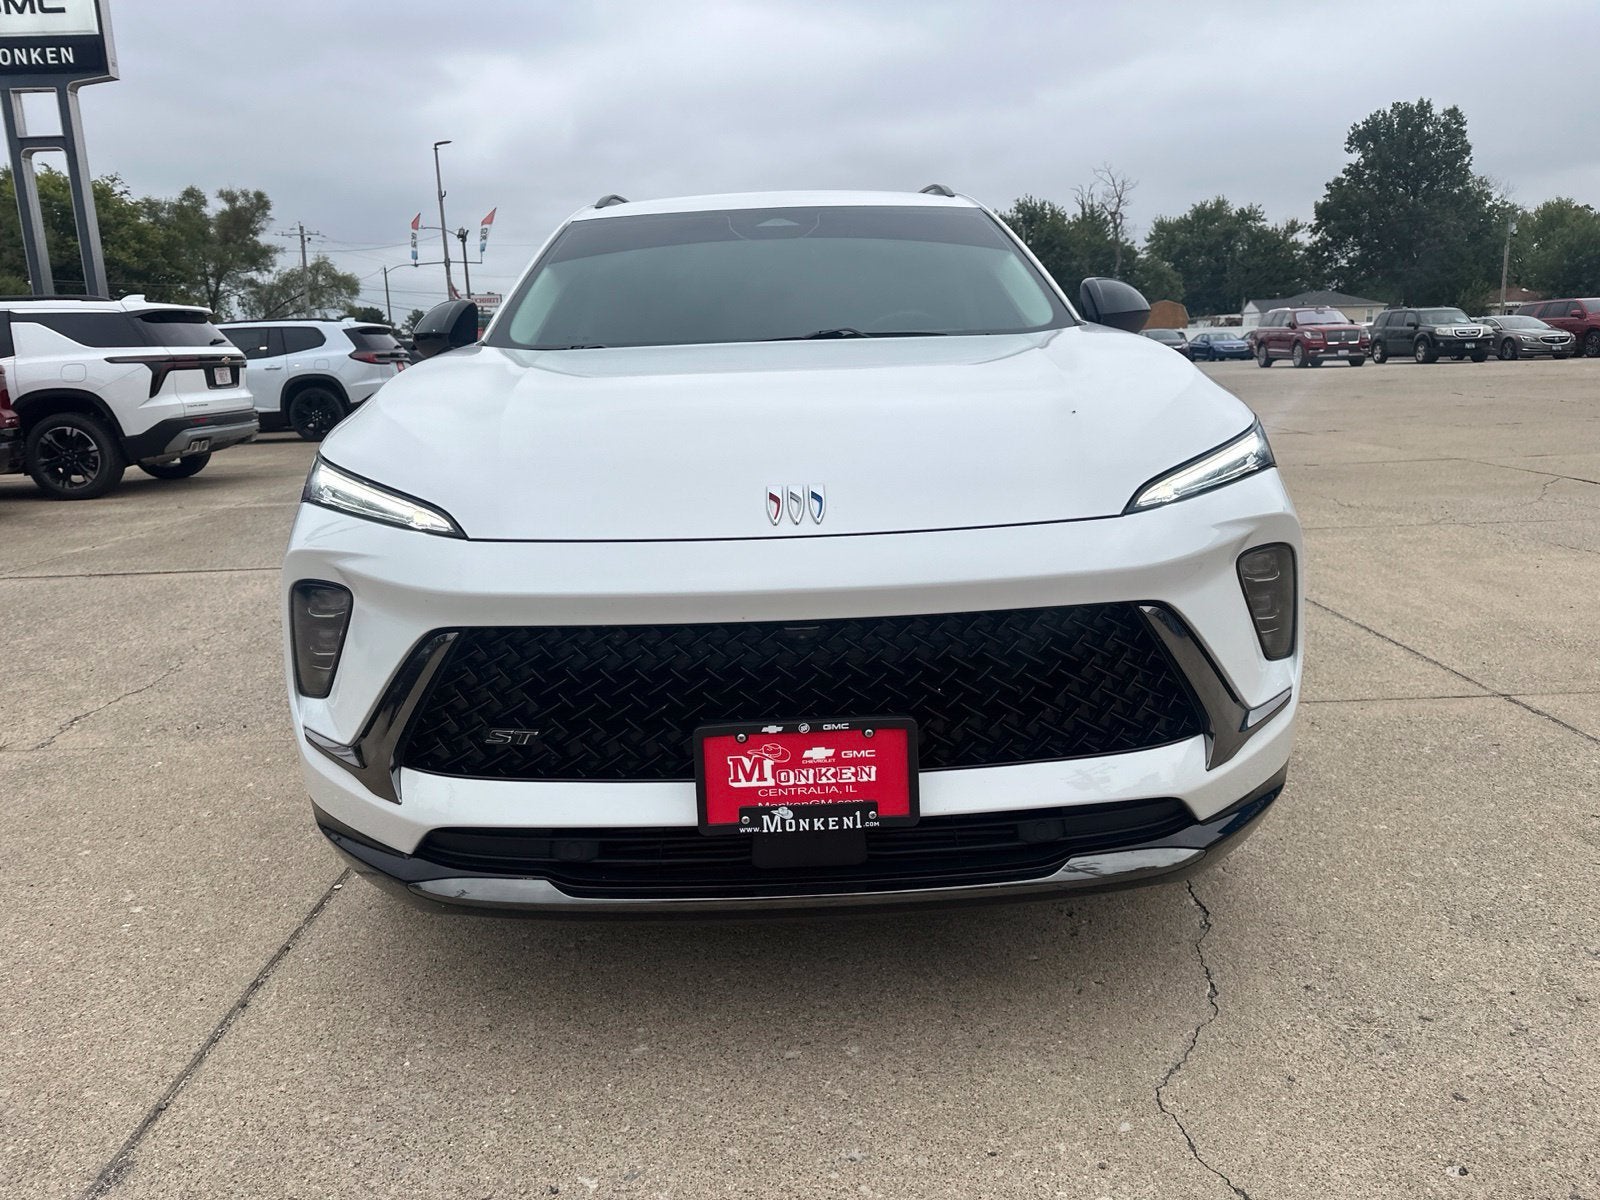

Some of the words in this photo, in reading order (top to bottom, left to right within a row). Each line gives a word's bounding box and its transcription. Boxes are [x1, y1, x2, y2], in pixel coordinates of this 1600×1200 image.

[0, 0, 66, 14] MC
[0, 47, 75, 66] ONKEN
[822, 722, 850, 731] GMC
[485, 729, 539, 745] ST
[841, 749, 876, 759] GMC
[757, 786, 842, 797] CENTRALIA,
[846, 785, 858, 793] IL
